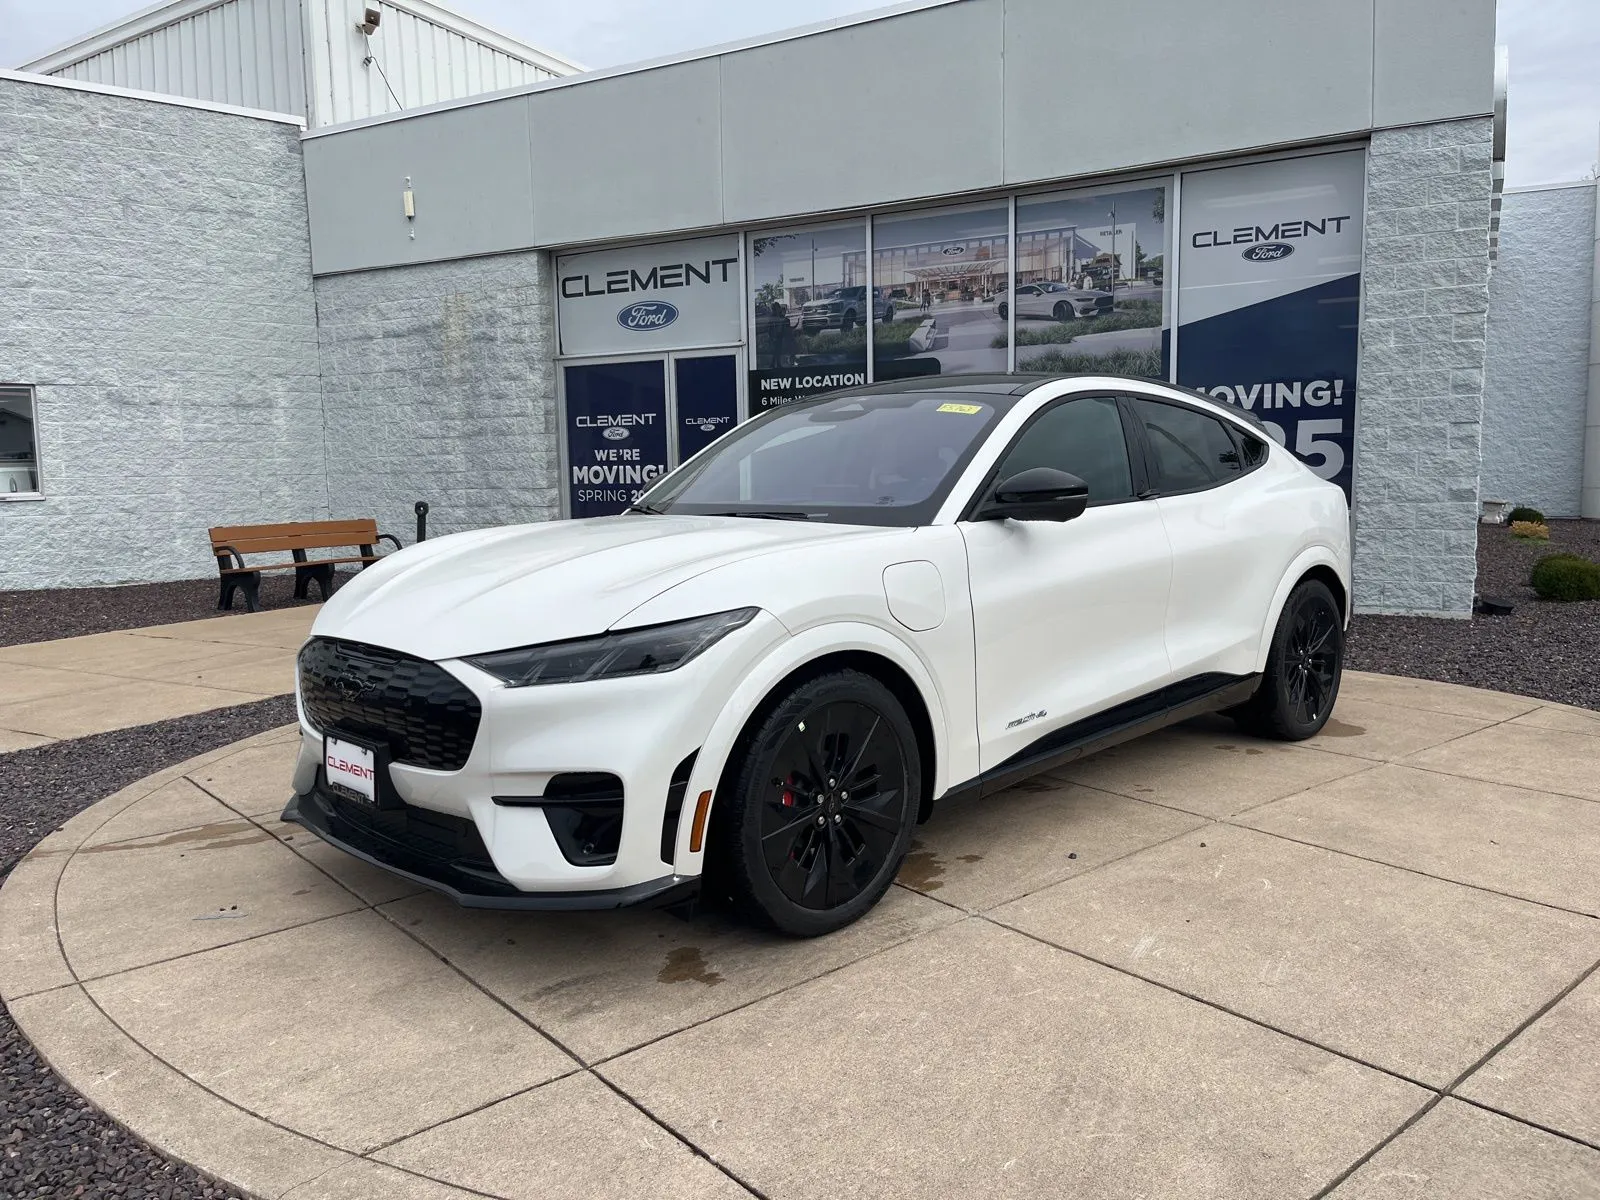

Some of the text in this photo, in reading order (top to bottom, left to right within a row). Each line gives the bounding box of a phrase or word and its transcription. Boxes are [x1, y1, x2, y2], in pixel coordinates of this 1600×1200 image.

[1192, 215, 1351, 248] CLEMENT
[1251, 245, 1284, 260] Ford
[561, 257, 738, 298] CLEMENT
[627, 305, 667, 327] Ford
[760, 373, 865, 391] NEW LOCATION
[761, 397, 768, 406] 6
[1195, 379, 1344, 411] OVING!
[575, 413, 657, 428] CLEMENT
[685, 416, 730, 425] CLEMENT
[594, 448, 641, 461] WE'RE
[578, 489, 627, 502] SPRING
[327, 755, 375, 781] CLEMENT
